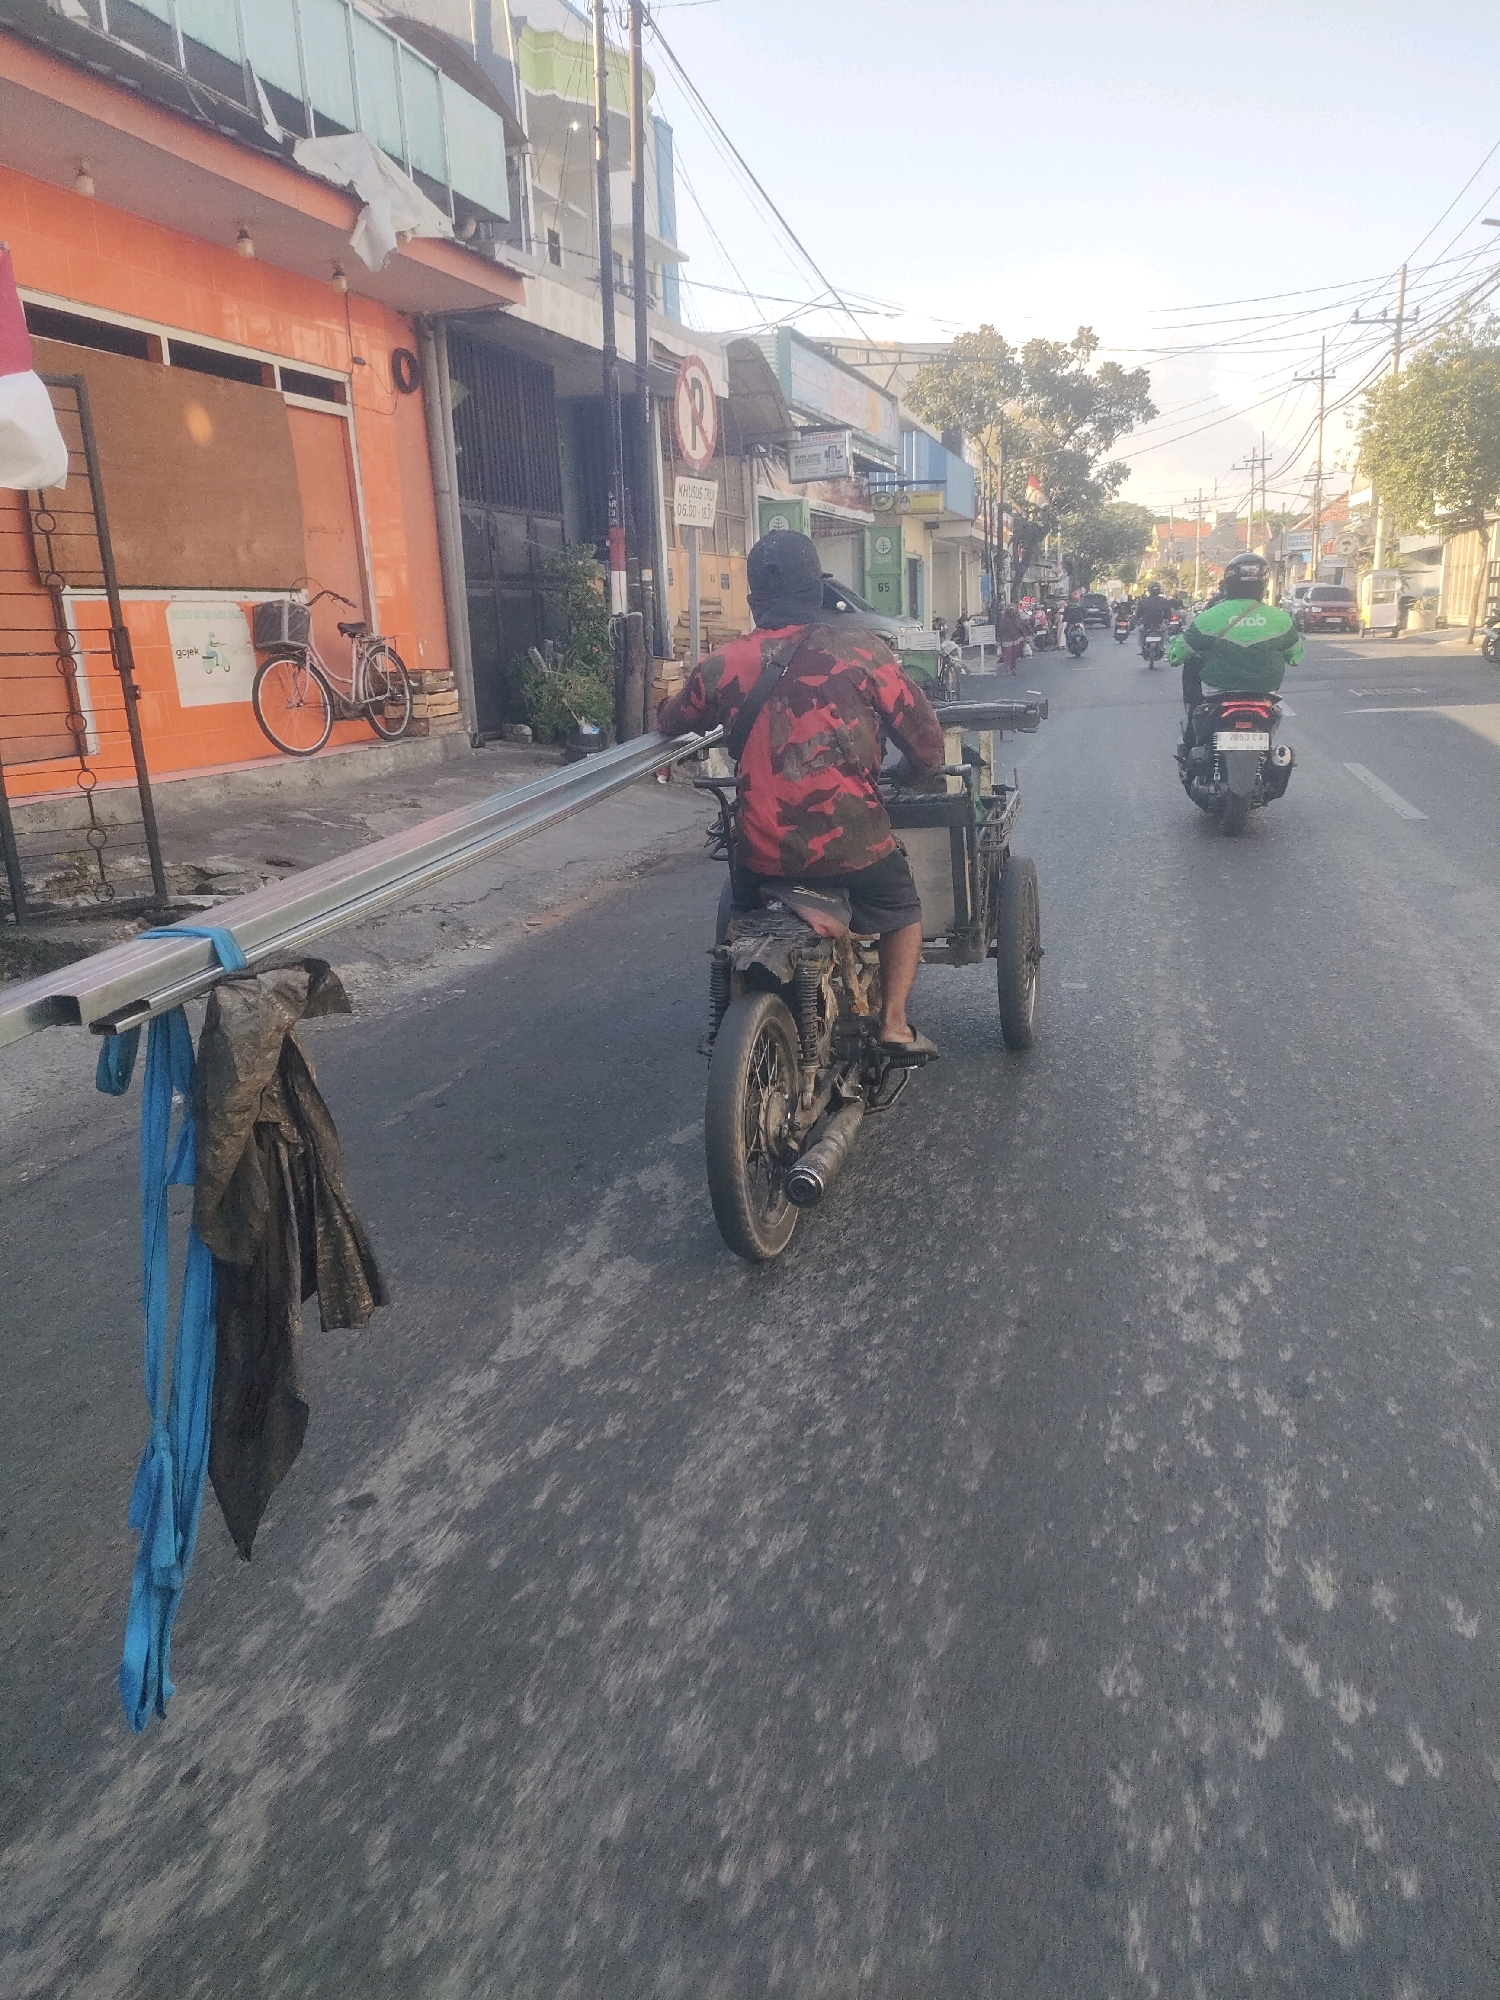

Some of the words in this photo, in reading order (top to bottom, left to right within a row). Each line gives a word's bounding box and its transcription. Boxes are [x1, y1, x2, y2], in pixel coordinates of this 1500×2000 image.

[691, 377, 705, 450] P
[678, 483, 702, 500] KHUSUS
[677, 503, 697, 518] 06.00
[878, 582, 890, 593] 65
[1228, 613, 1267, 627] Grab
[175, 646, 199, 659] gojek
